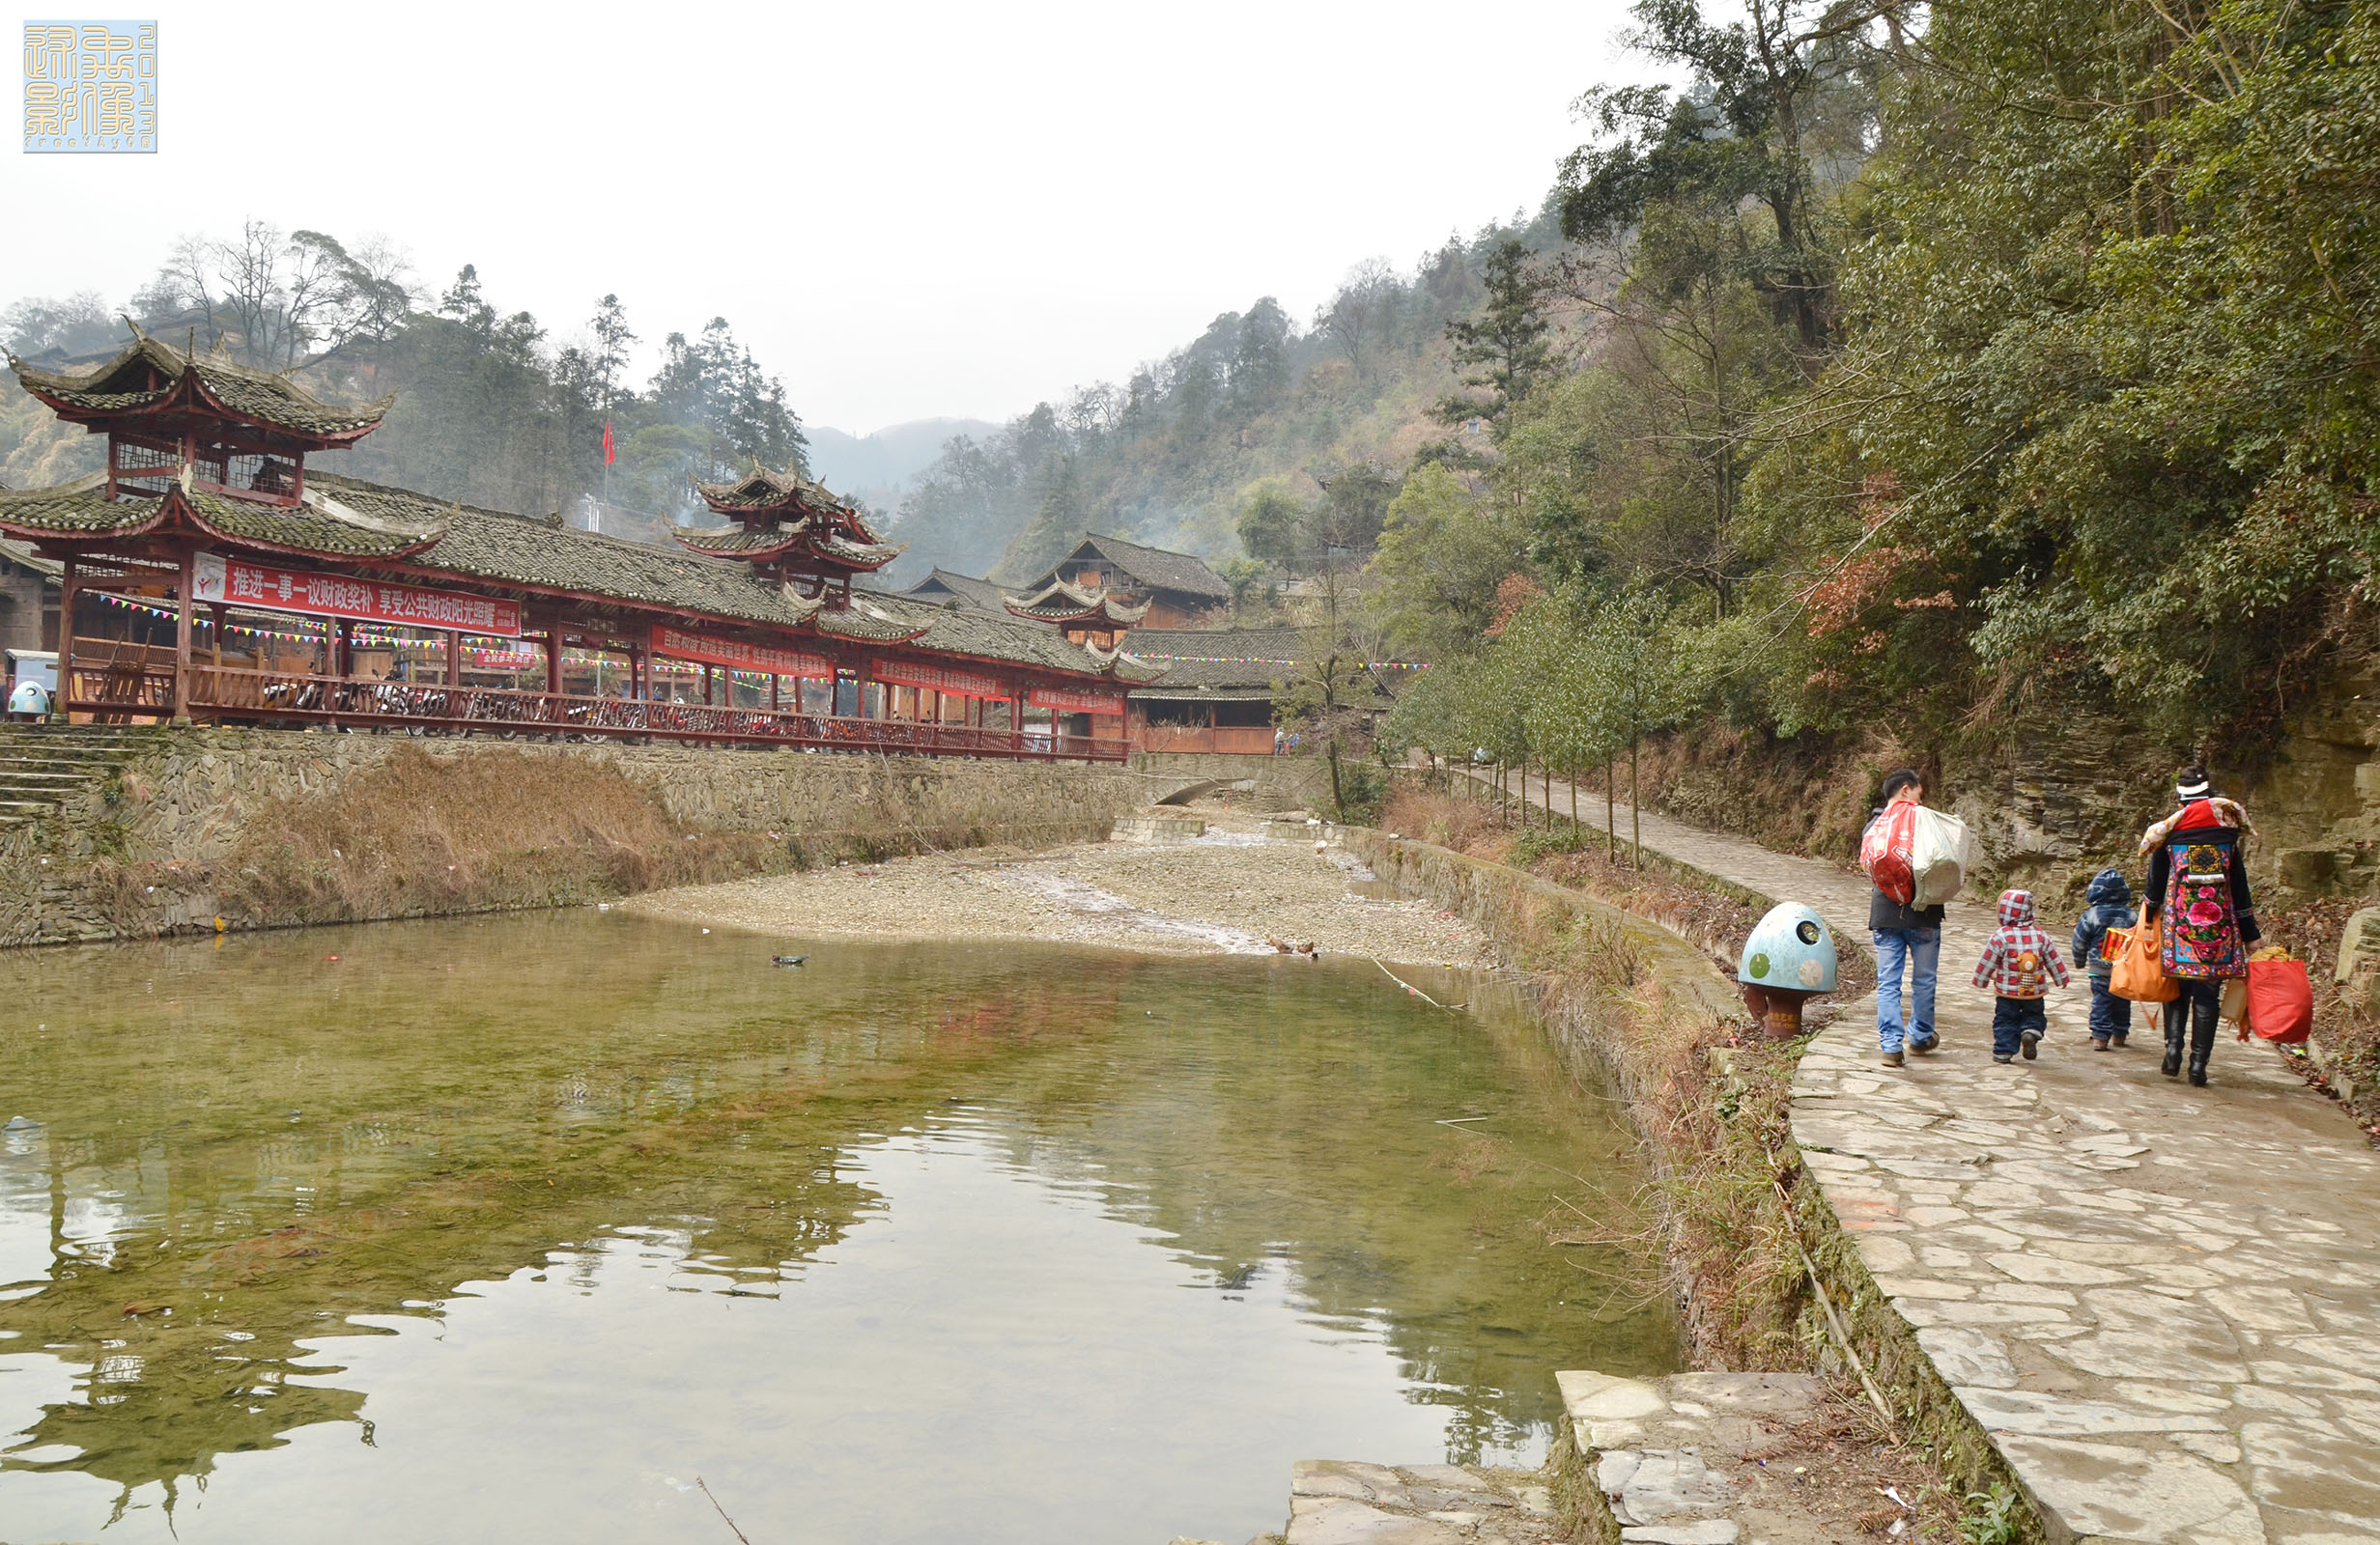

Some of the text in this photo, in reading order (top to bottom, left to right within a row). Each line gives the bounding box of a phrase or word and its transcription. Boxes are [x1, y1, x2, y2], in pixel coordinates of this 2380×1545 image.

[233, 568, 496, 628] 推进一事一议财政奖补 享受公共财政阳光照耀
